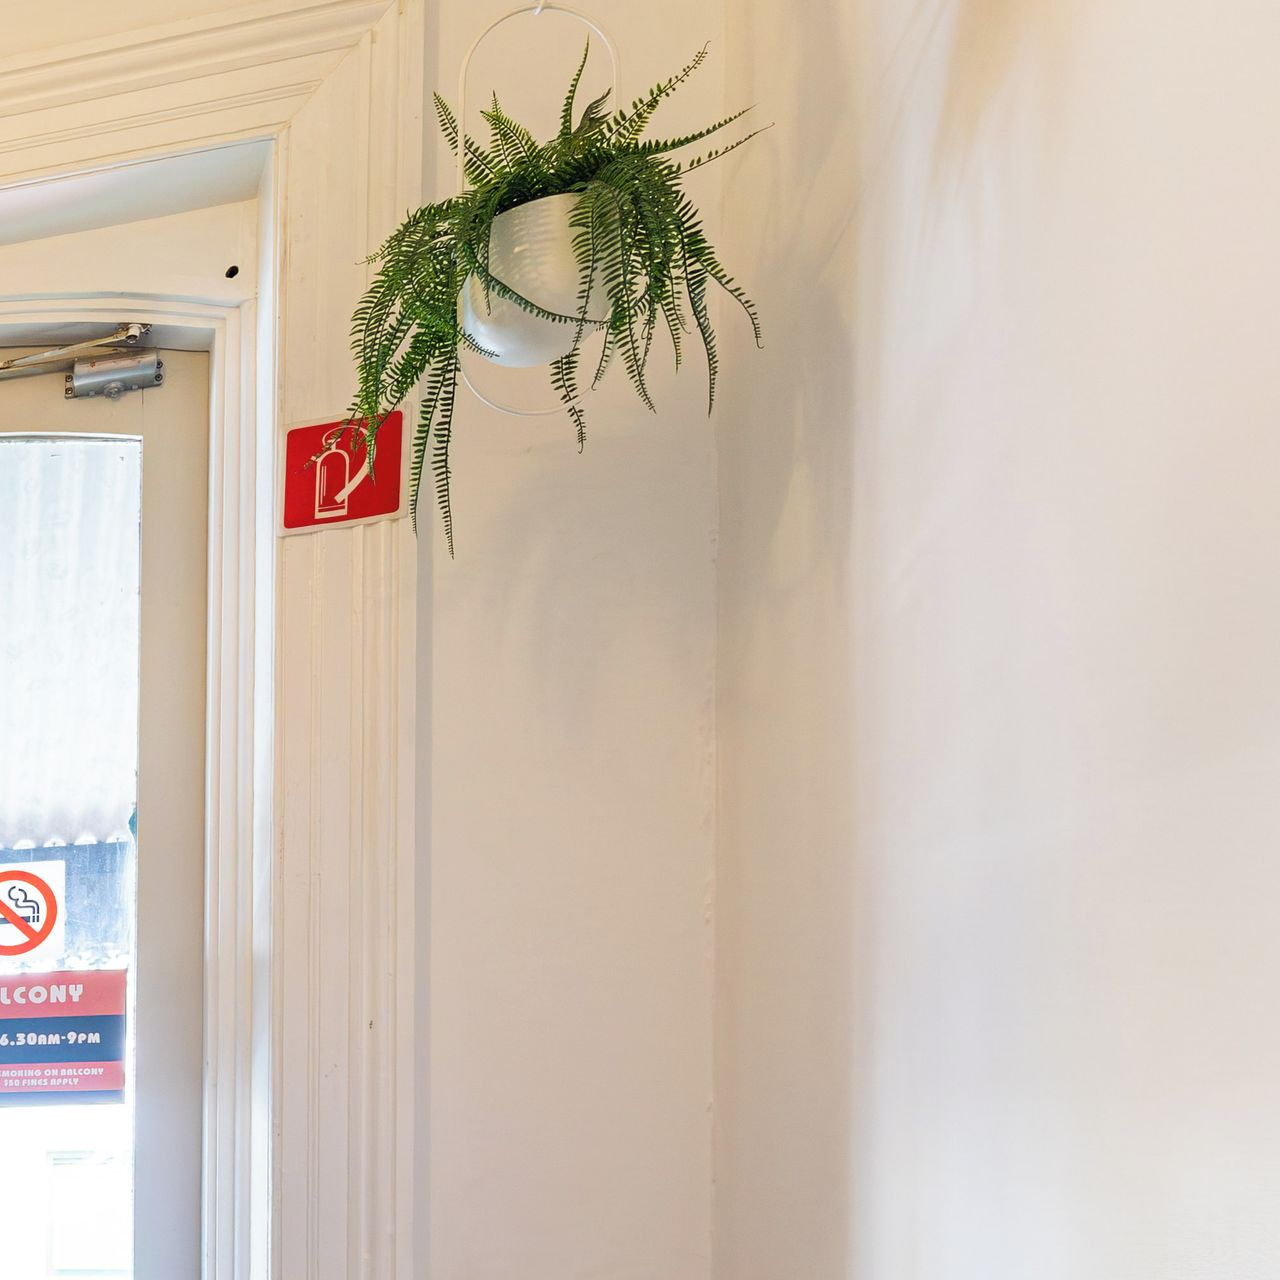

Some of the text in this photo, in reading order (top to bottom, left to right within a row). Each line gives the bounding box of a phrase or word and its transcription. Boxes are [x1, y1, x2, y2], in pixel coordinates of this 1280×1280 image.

[0, 1031, 101, 1047] 6.30AM-9PM
[44, 1068, 58, 1076] ON
[60, 1067, 104, 1076] BALCONY
[22, 1078, 49, 1086] FINES
[50, 1077, 79, 1086] APPLY
